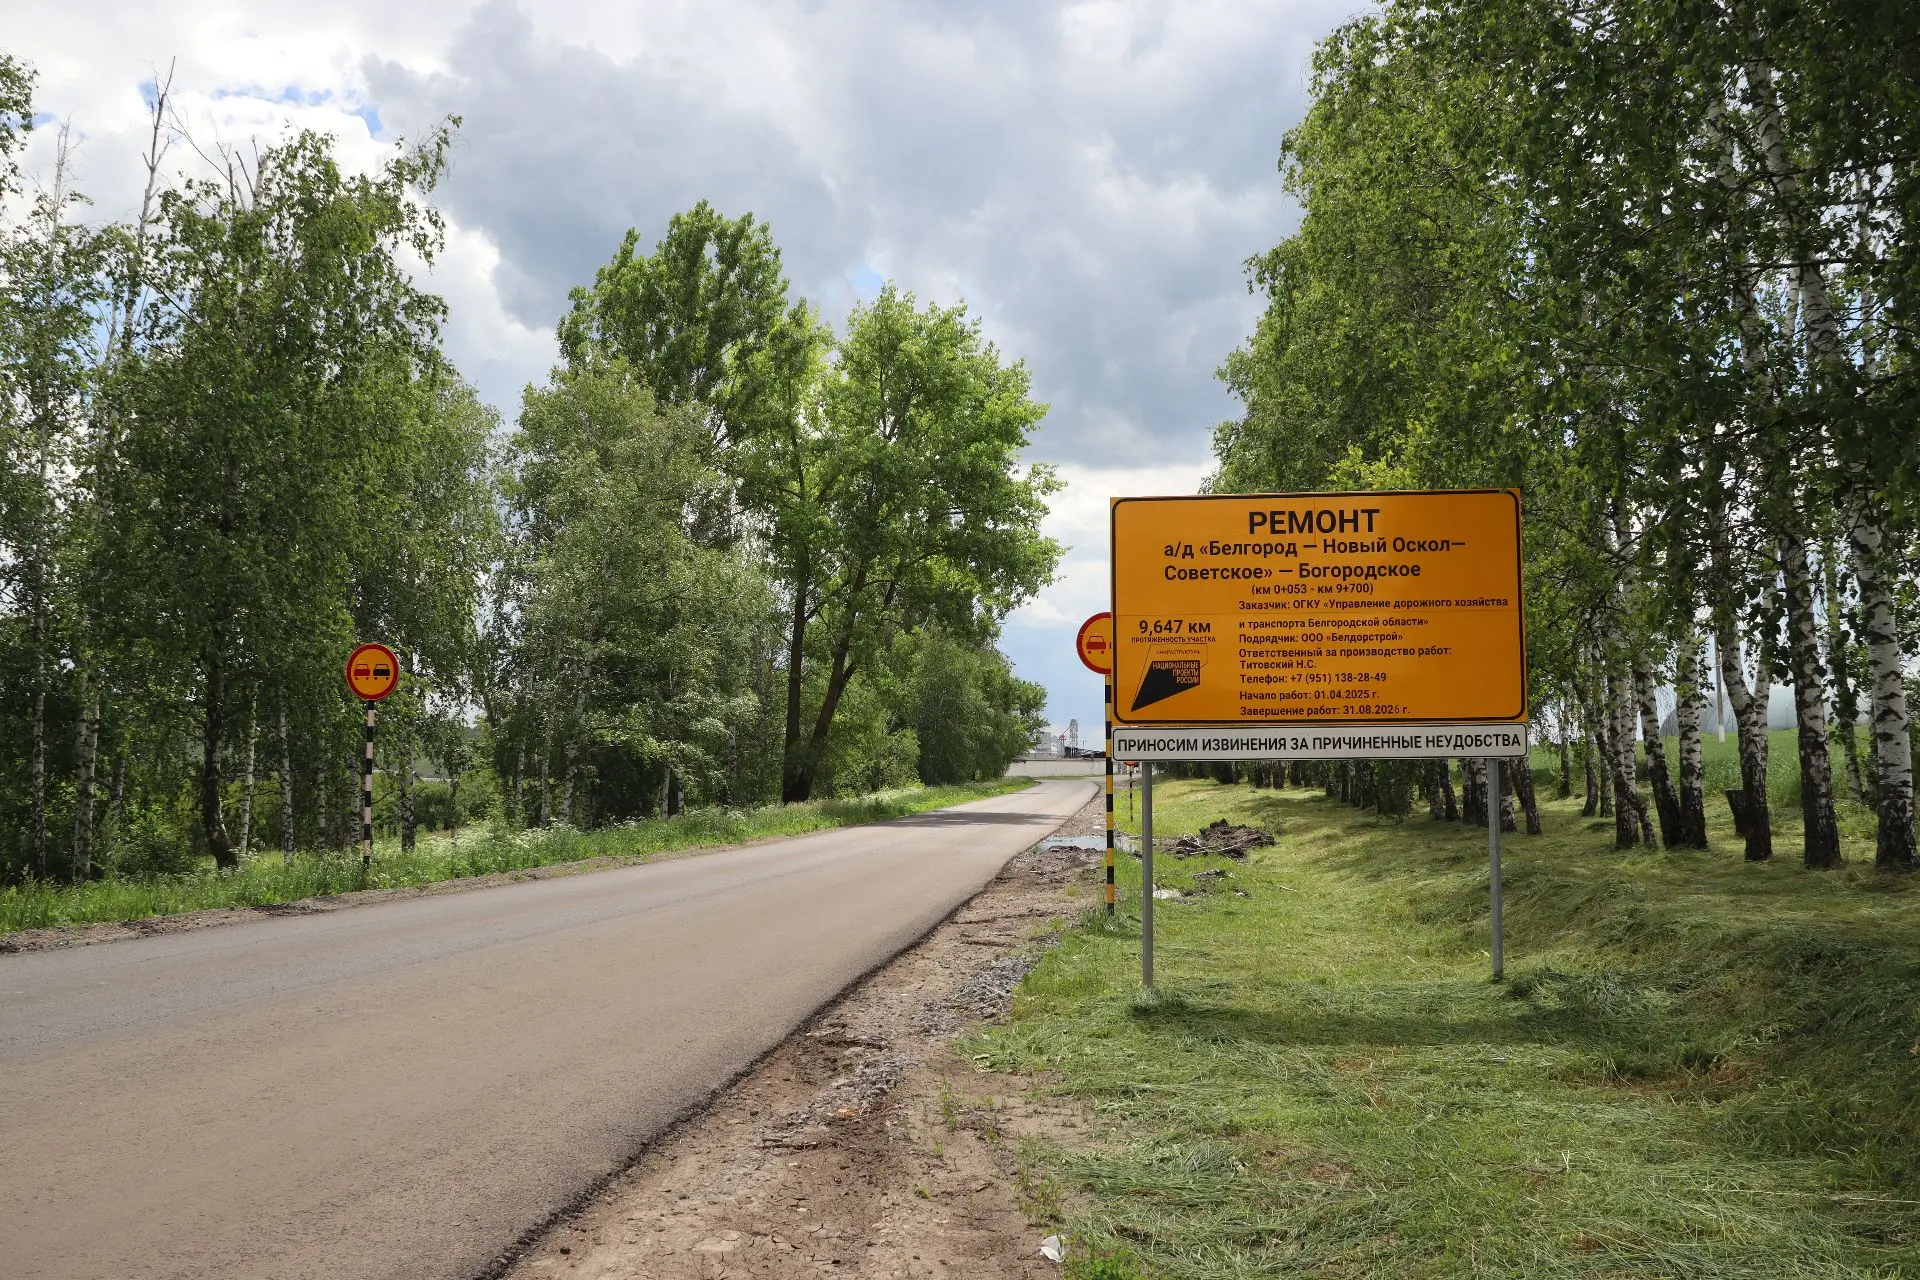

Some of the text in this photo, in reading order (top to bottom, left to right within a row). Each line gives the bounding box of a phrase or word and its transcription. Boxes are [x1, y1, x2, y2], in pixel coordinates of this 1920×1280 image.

[1249, 508, 1380, 534] РЕМОНТ
[1164, 541, 1194, 559] а/д
[1200, 540, 1297, 558] «Белгород
[1323, 537, 1387, 553] Новый
[1164, 564, 1273, 580] Советское»
[1299, 562, 1421, 581] Богородское
[1251, 585, 1271, 595] (км
[1274, 584, 1307, 594] 0+053
[1317, 585, 1333, 593] км
[1336, 583, 1374, 595] 9+700)
[1239, 597, 1508, 610] Заказчик: ОГКУ «Управление дорожного хозяйства
[1139, 619, 1211, 636] 9,647 км
[1239, 617, 1429, 630] и транспорта Белгородской области»
[1239, 631, 1403, 644] Подрядчик: ООО «Белдорстрой»
[1239, 645, 1452, 658] Ответственный за производство работ:
[1152, 661, 1199, 670] НАЦИОНАЛЬНЫЕ
[1240, 659, 1317, 670] Титовский Н.С.
[1172, 669, 1199, 677] ПРОЕКТЫ
[1240, 672, 1387, 685] Телефон: +7 (951) 138-28-49
[1176, 676, 1199, 684] РОССИИ
[1240, 691, 1277, 700] Начало
[1280, 690, 1312, 702] работ:
[1314, 690, 1370, 699] 01.04.2025
[1240, 706, 1304, 717] Завершение
[1307, 705, 1340, 717] работ:
[1118, 733, 1521, 751] ПРИНОСИМ ИЗВИНЕНИЯ ЗА ПРИЧИНЕННЫЕ НЕУДОБСТВА
